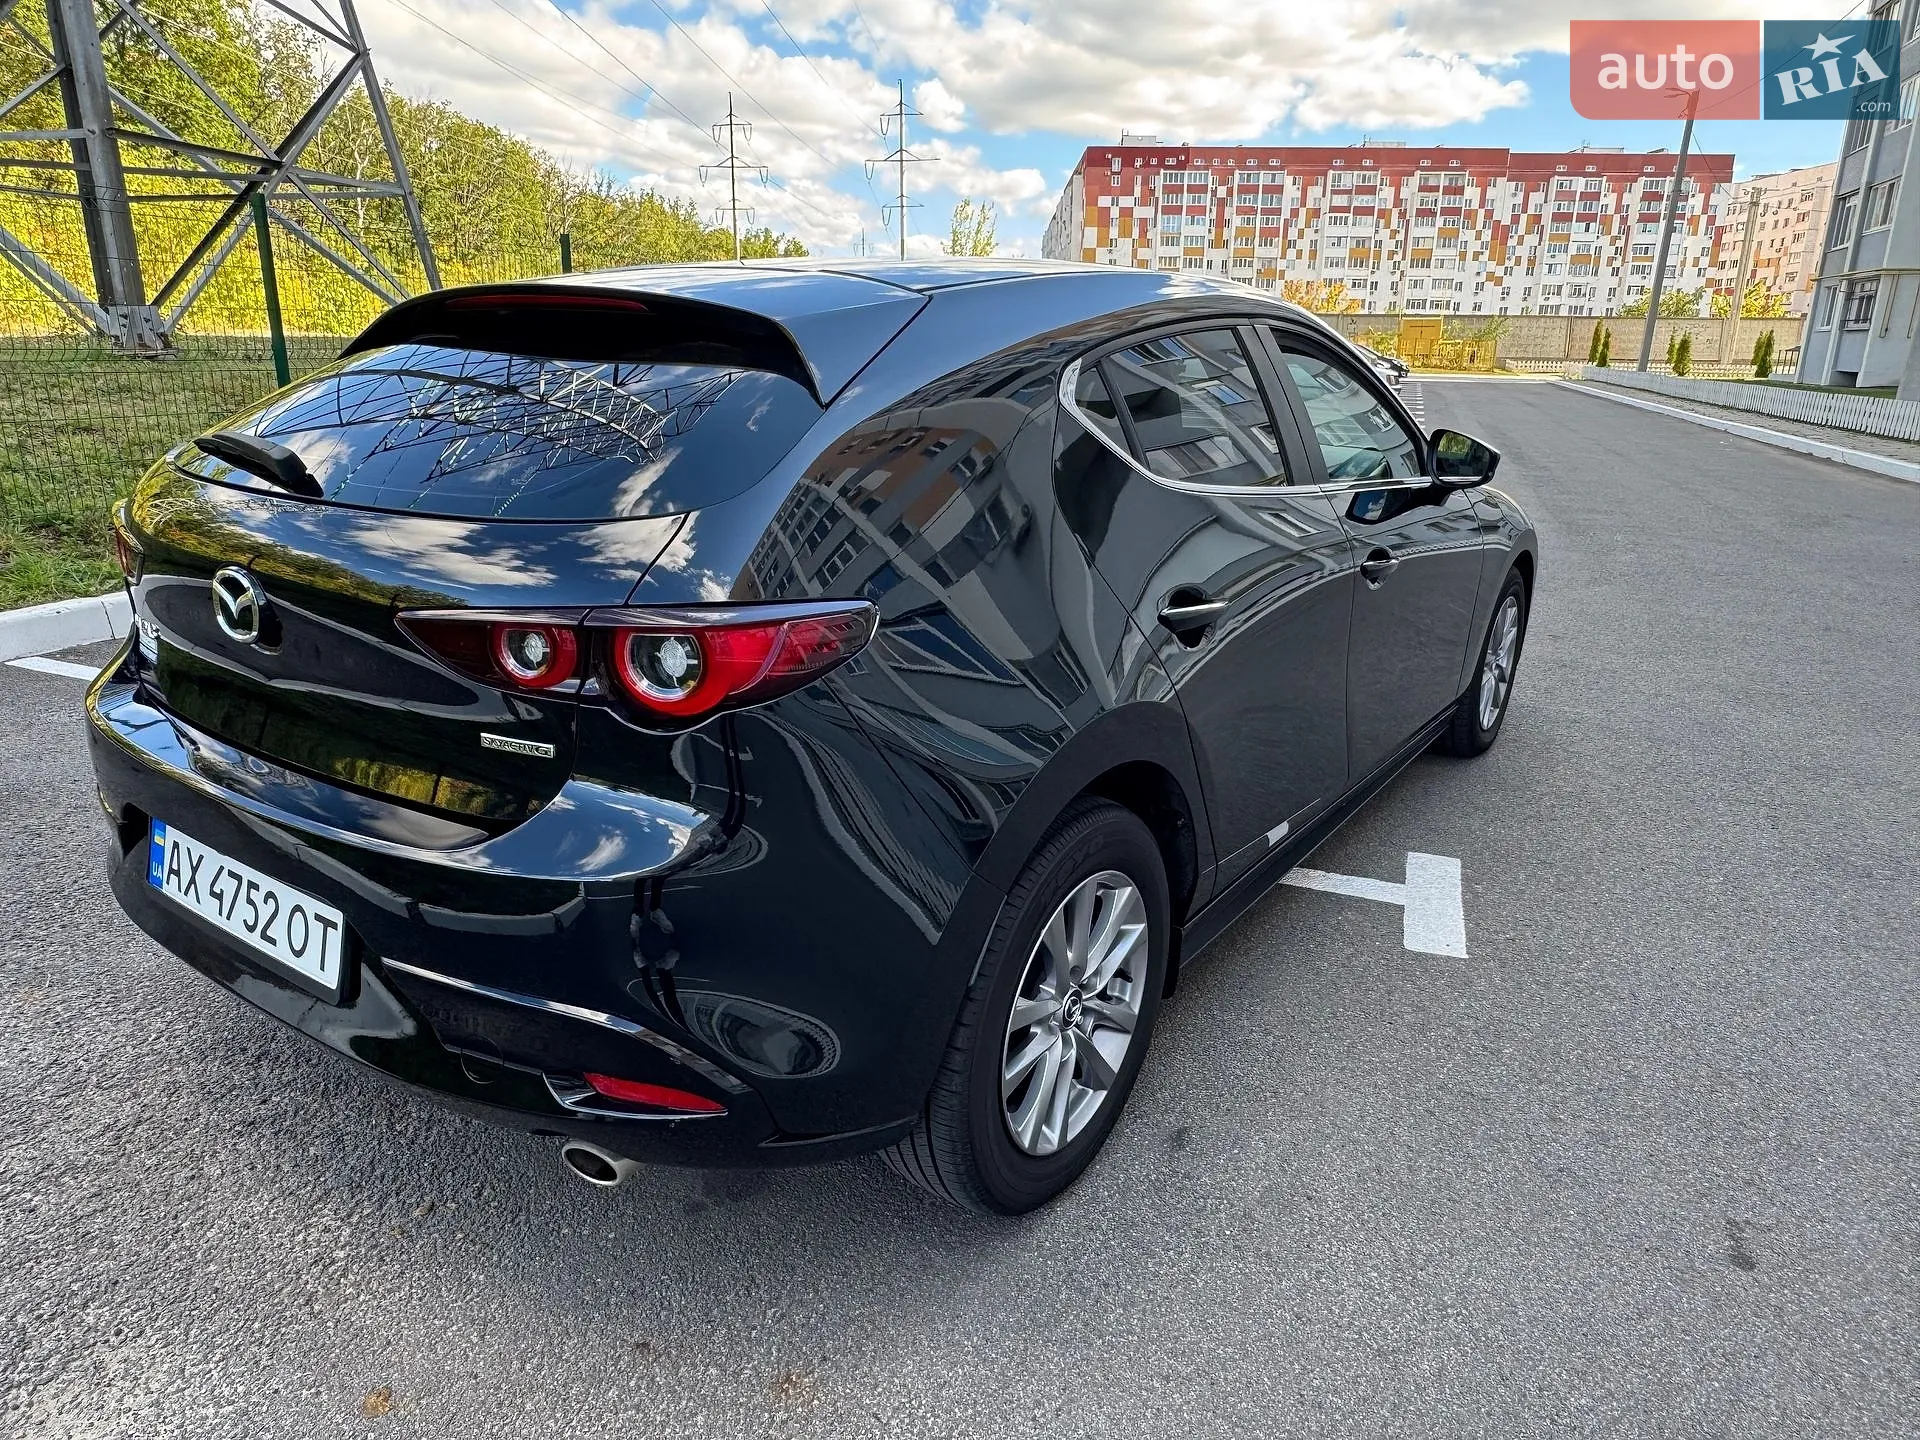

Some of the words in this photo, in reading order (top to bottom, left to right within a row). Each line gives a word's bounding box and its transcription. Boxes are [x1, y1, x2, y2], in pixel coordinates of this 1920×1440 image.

[152, 861, 163, 879] UA
[166, 840, 204, 905] AX
[208, 865, 280, 947] 4752
[287, 904, 338, 972] OT
